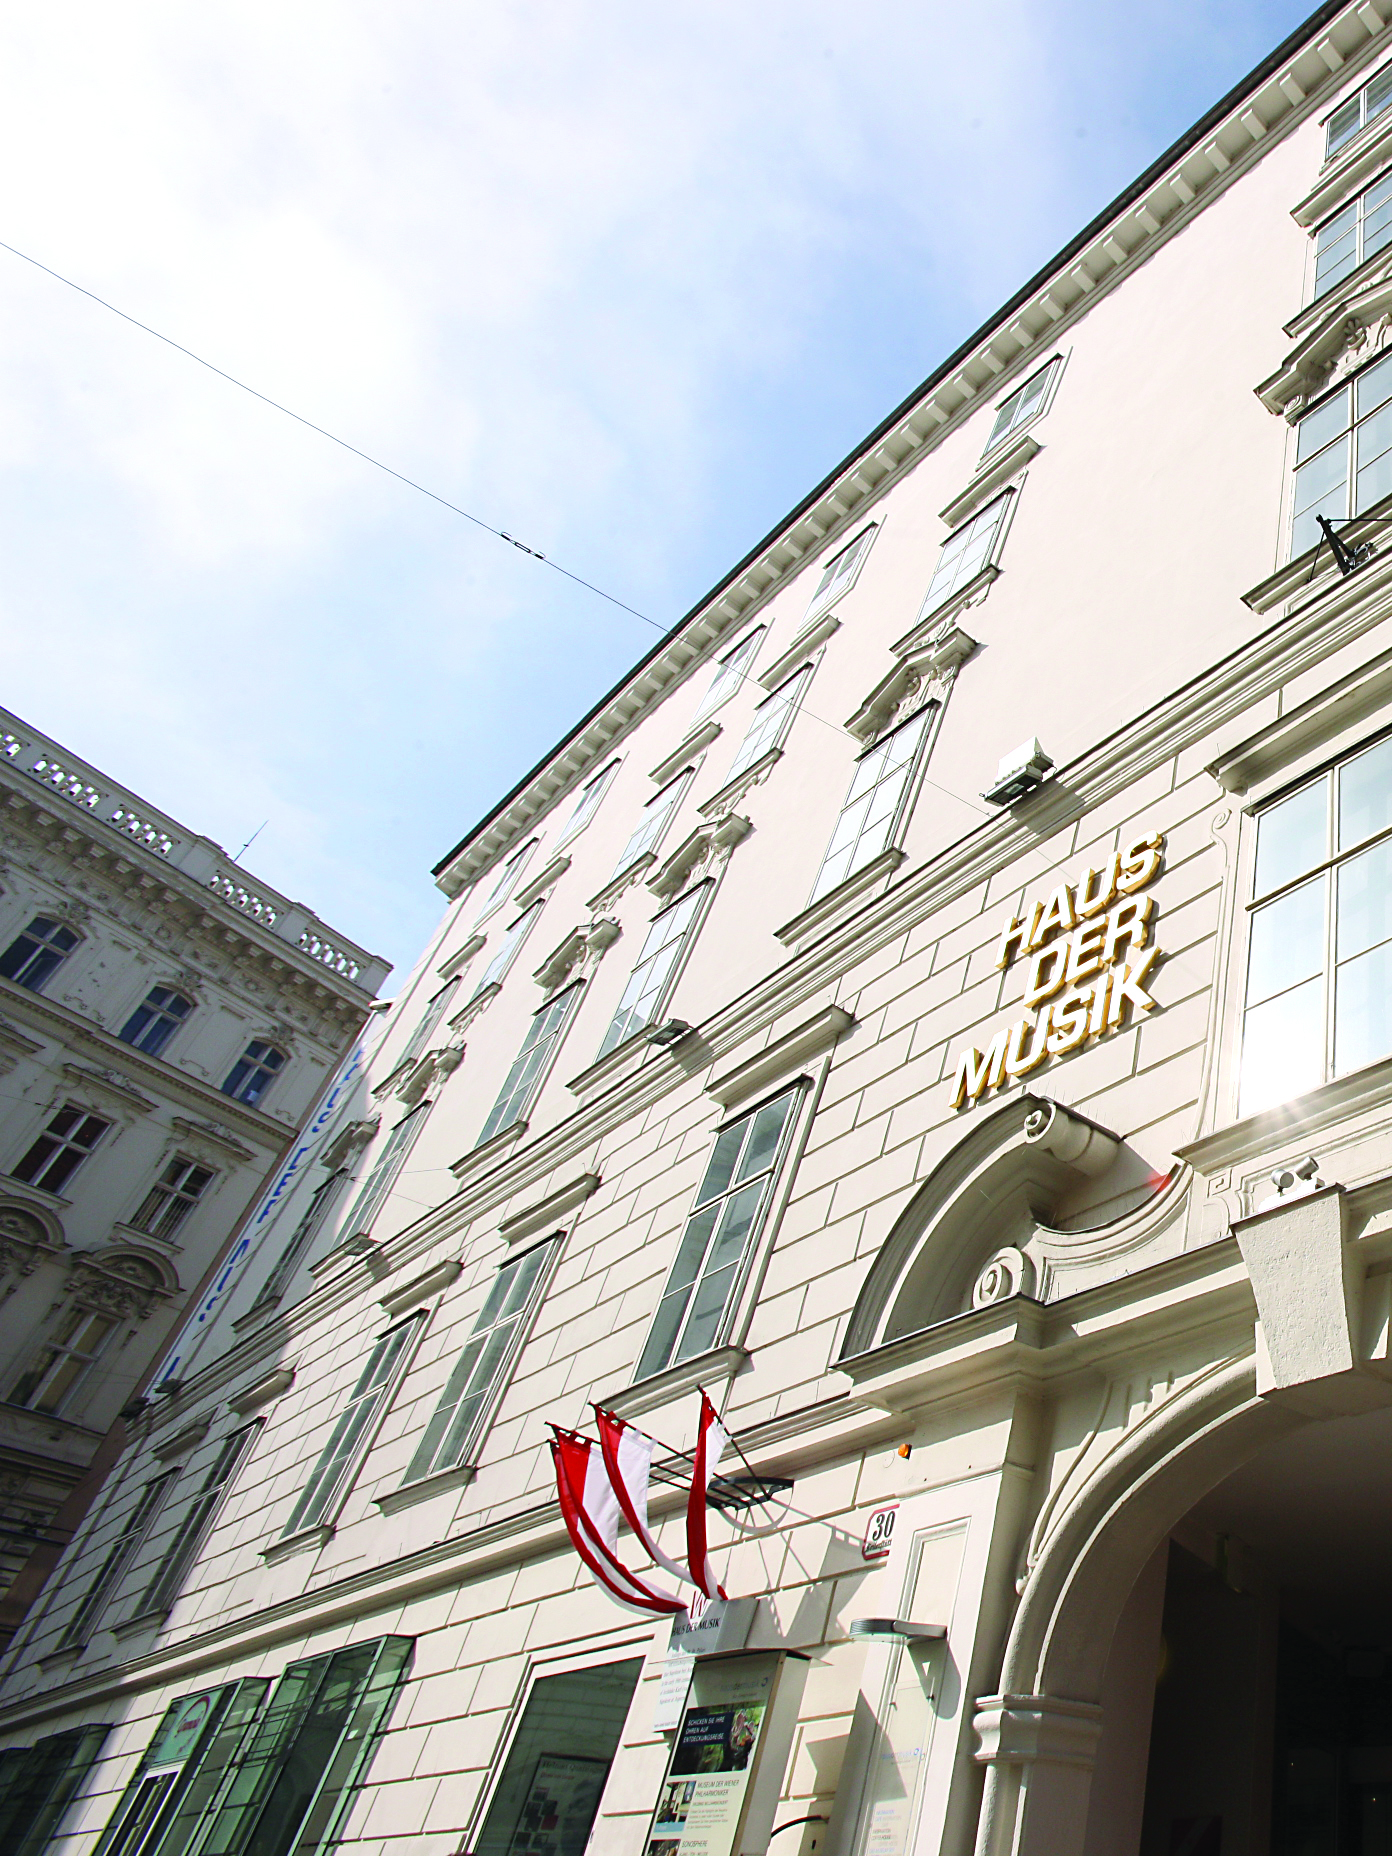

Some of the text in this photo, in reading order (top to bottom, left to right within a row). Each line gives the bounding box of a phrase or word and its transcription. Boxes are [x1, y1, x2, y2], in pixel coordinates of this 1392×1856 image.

[995, 830, 1163, 969] HAUS
[1023, 893, 1152, 1008] DER
[948, 946, 1162, 1109] MUSIK
[872, 1511, 895, 1541] 30
